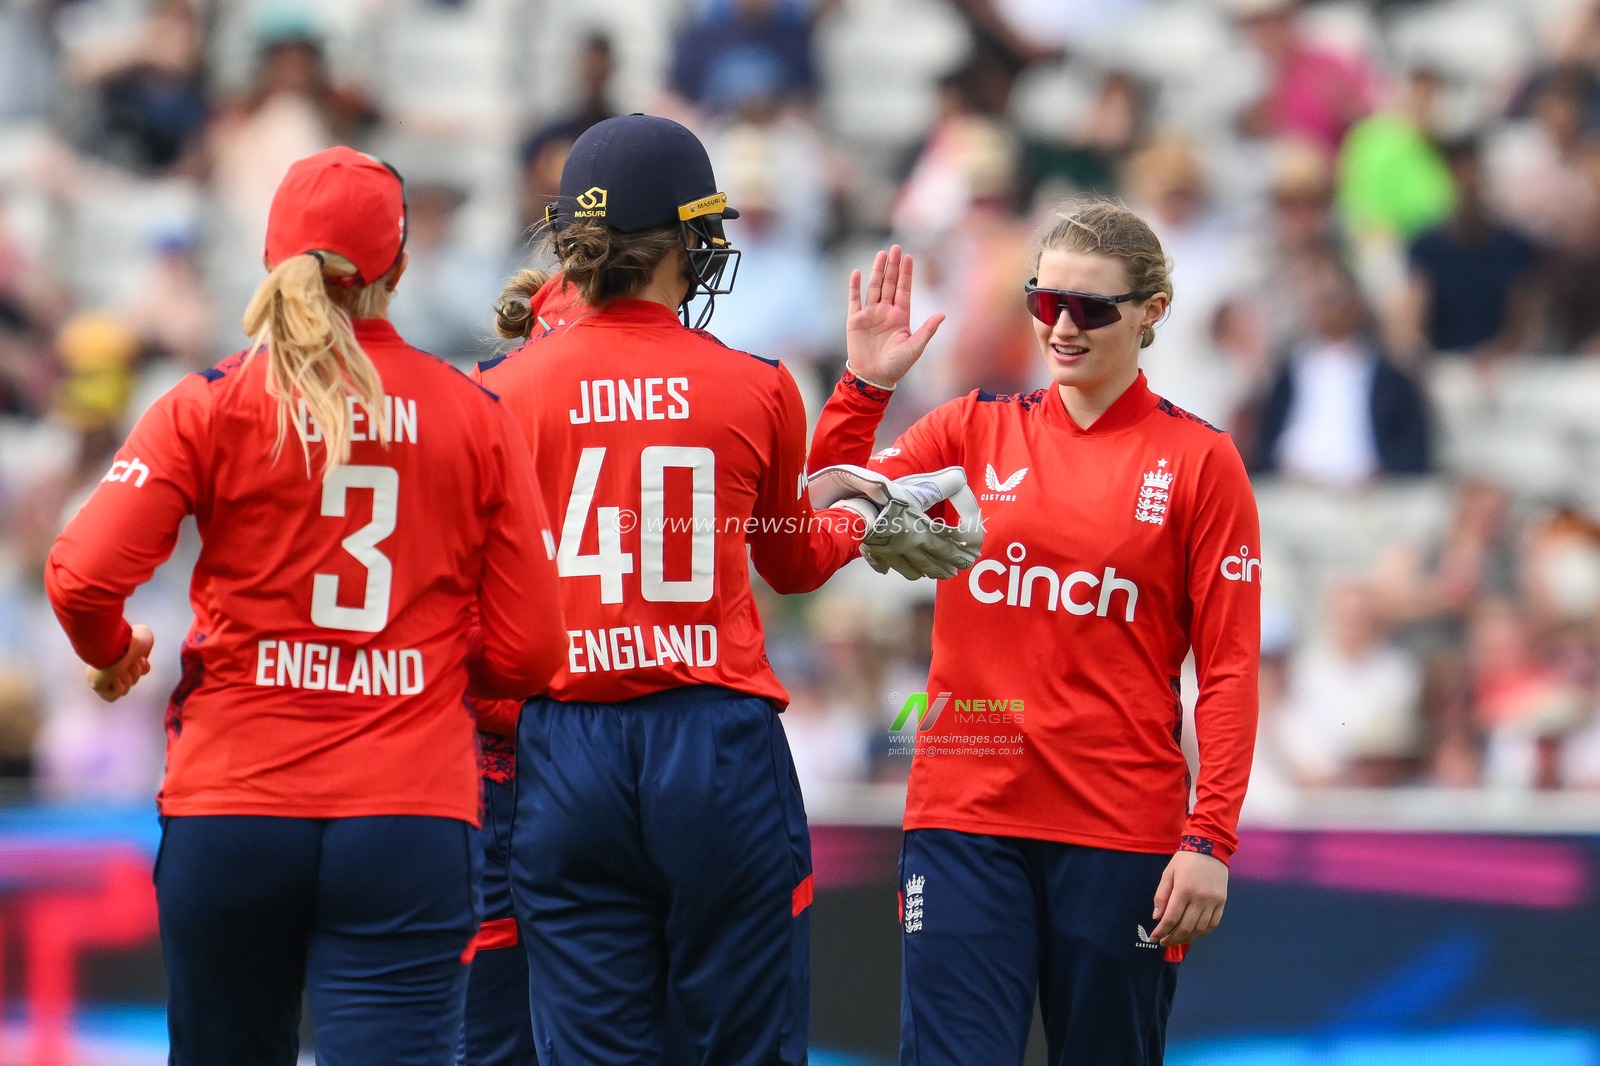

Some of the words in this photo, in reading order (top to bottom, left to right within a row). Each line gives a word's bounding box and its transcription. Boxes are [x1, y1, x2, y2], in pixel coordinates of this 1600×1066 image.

[574, 210, 606, 218] MASURI
[697, 197, 721, 210] MASURI
[569, 377, 690, 425] JONES
[310, 464, 399, 633] 3
[556, 446, 715, 604] 40
[968, 541, 1139, 622] cinch
[1220, 545, 1264, 583] cin
[255, 639, 425, 696] ENGLAND
[567, 624, 718, 673] ENGLAND
